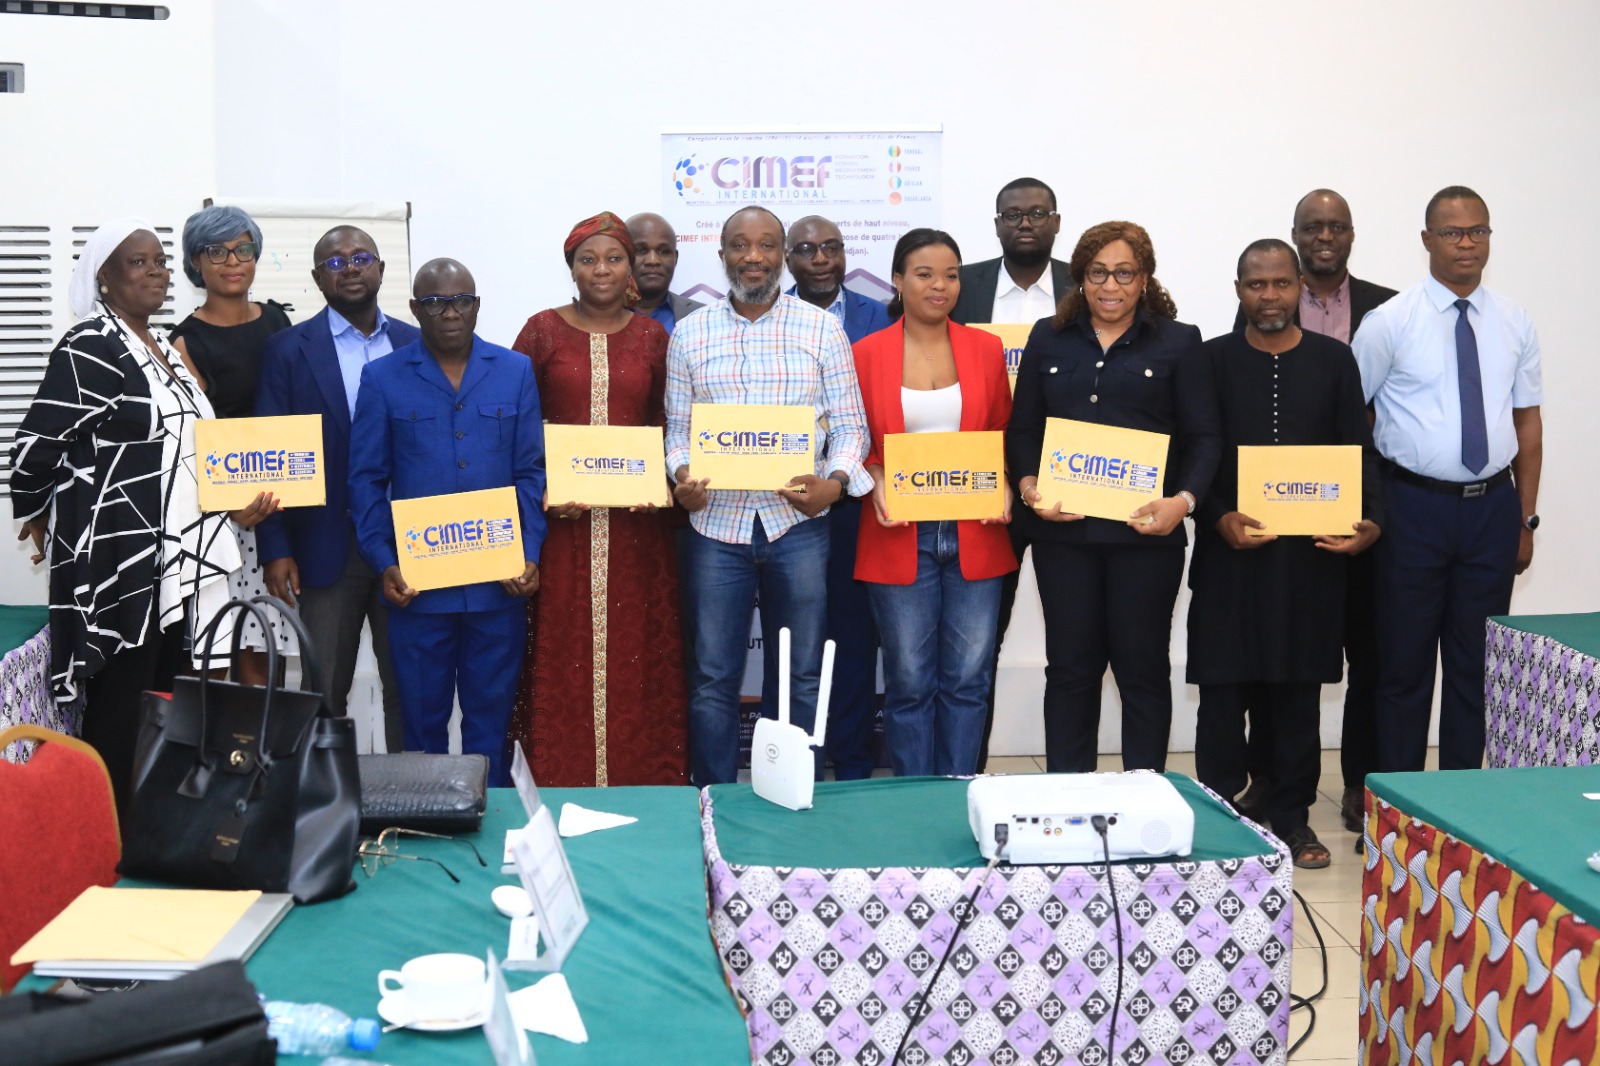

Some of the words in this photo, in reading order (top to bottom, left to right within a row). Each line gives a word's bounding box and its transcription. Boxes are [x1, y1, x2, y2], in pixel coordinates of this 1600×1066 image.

[710, 155, 832, 189] CIMEF
[718, 189, 828, 199] INTERNATIONAL
[852, 219, 862, 227] de
[864, 219, 881, 227] haut
[860, 233, 870, 241] de
[871, 233, 896, 243] quatre
[716, 431, 780, 447] CIMEF
[224, 450, 286, 473] CIMEF
[584, 457, 626, 469] CIMEF
[1068, 453, 1131, 479] CIMEF
[228, 471, 284, 480] INTERNATIONAL
[911, 470, 970, 487] CIMEF
[1069, 473, 1125, 486] INTERNATIONAL
[1276, 482, 1319, 495] CIMEF
[423, 518, 484, 547] CIMEF
[428, 541, 484, 553] INTERNATIONAL
